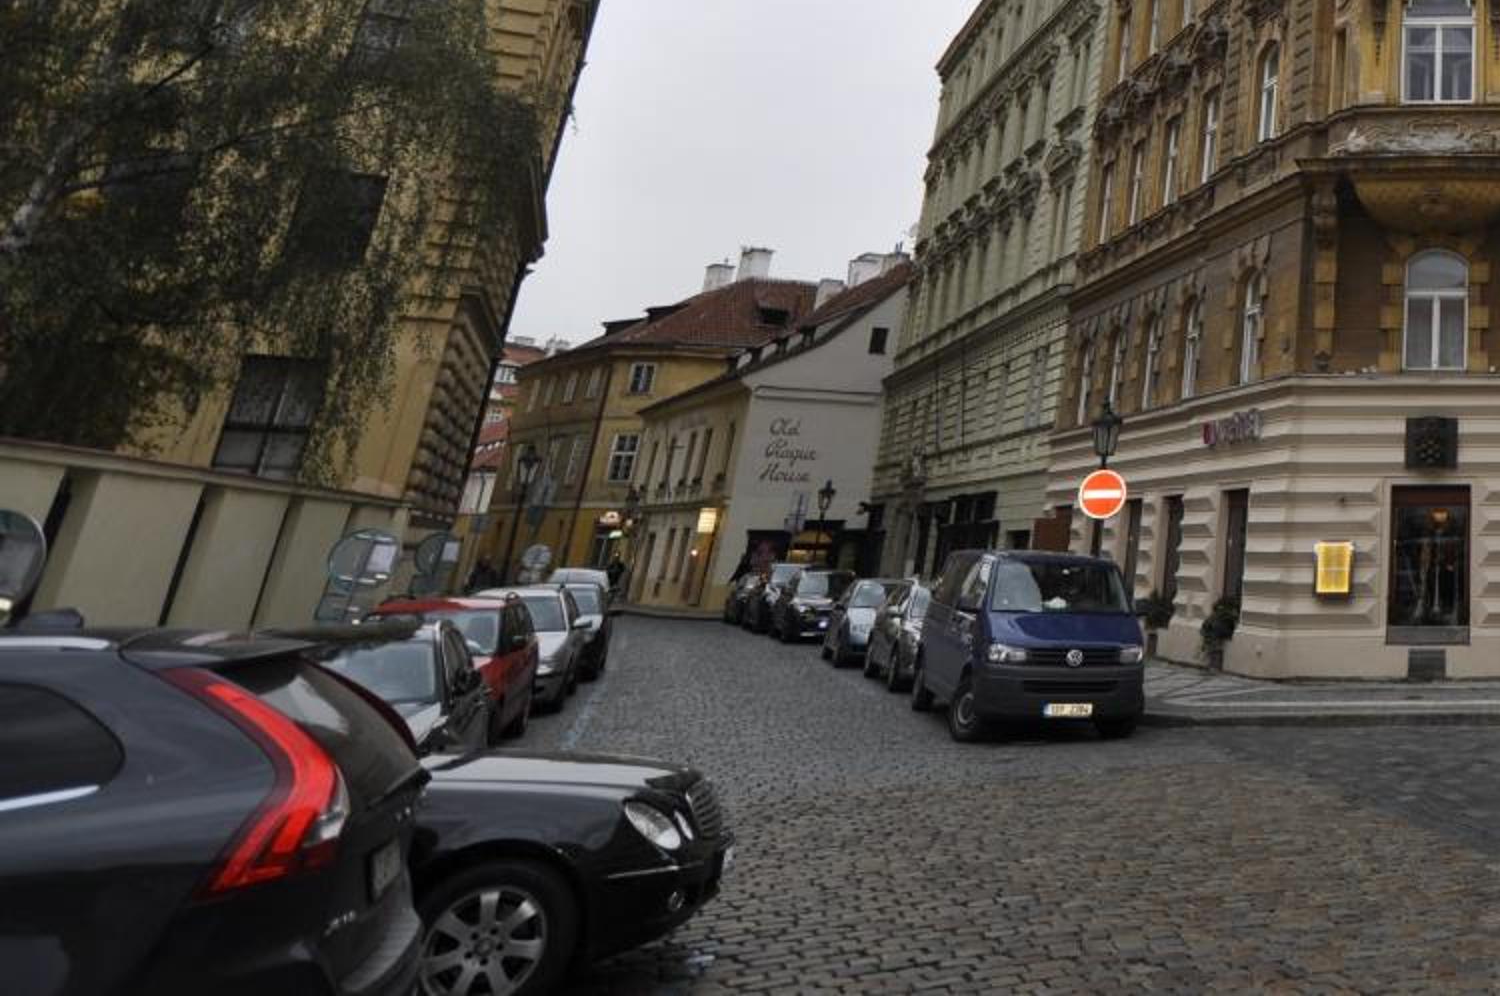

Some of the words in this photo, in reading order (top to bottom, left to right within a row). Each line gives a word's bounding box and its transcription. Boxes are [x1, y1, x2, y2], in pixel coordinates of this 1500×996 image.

[769, 418, 801, 436] Old
[765, 437, 817, 467] Prague
[758, 462, 810, 482] House
